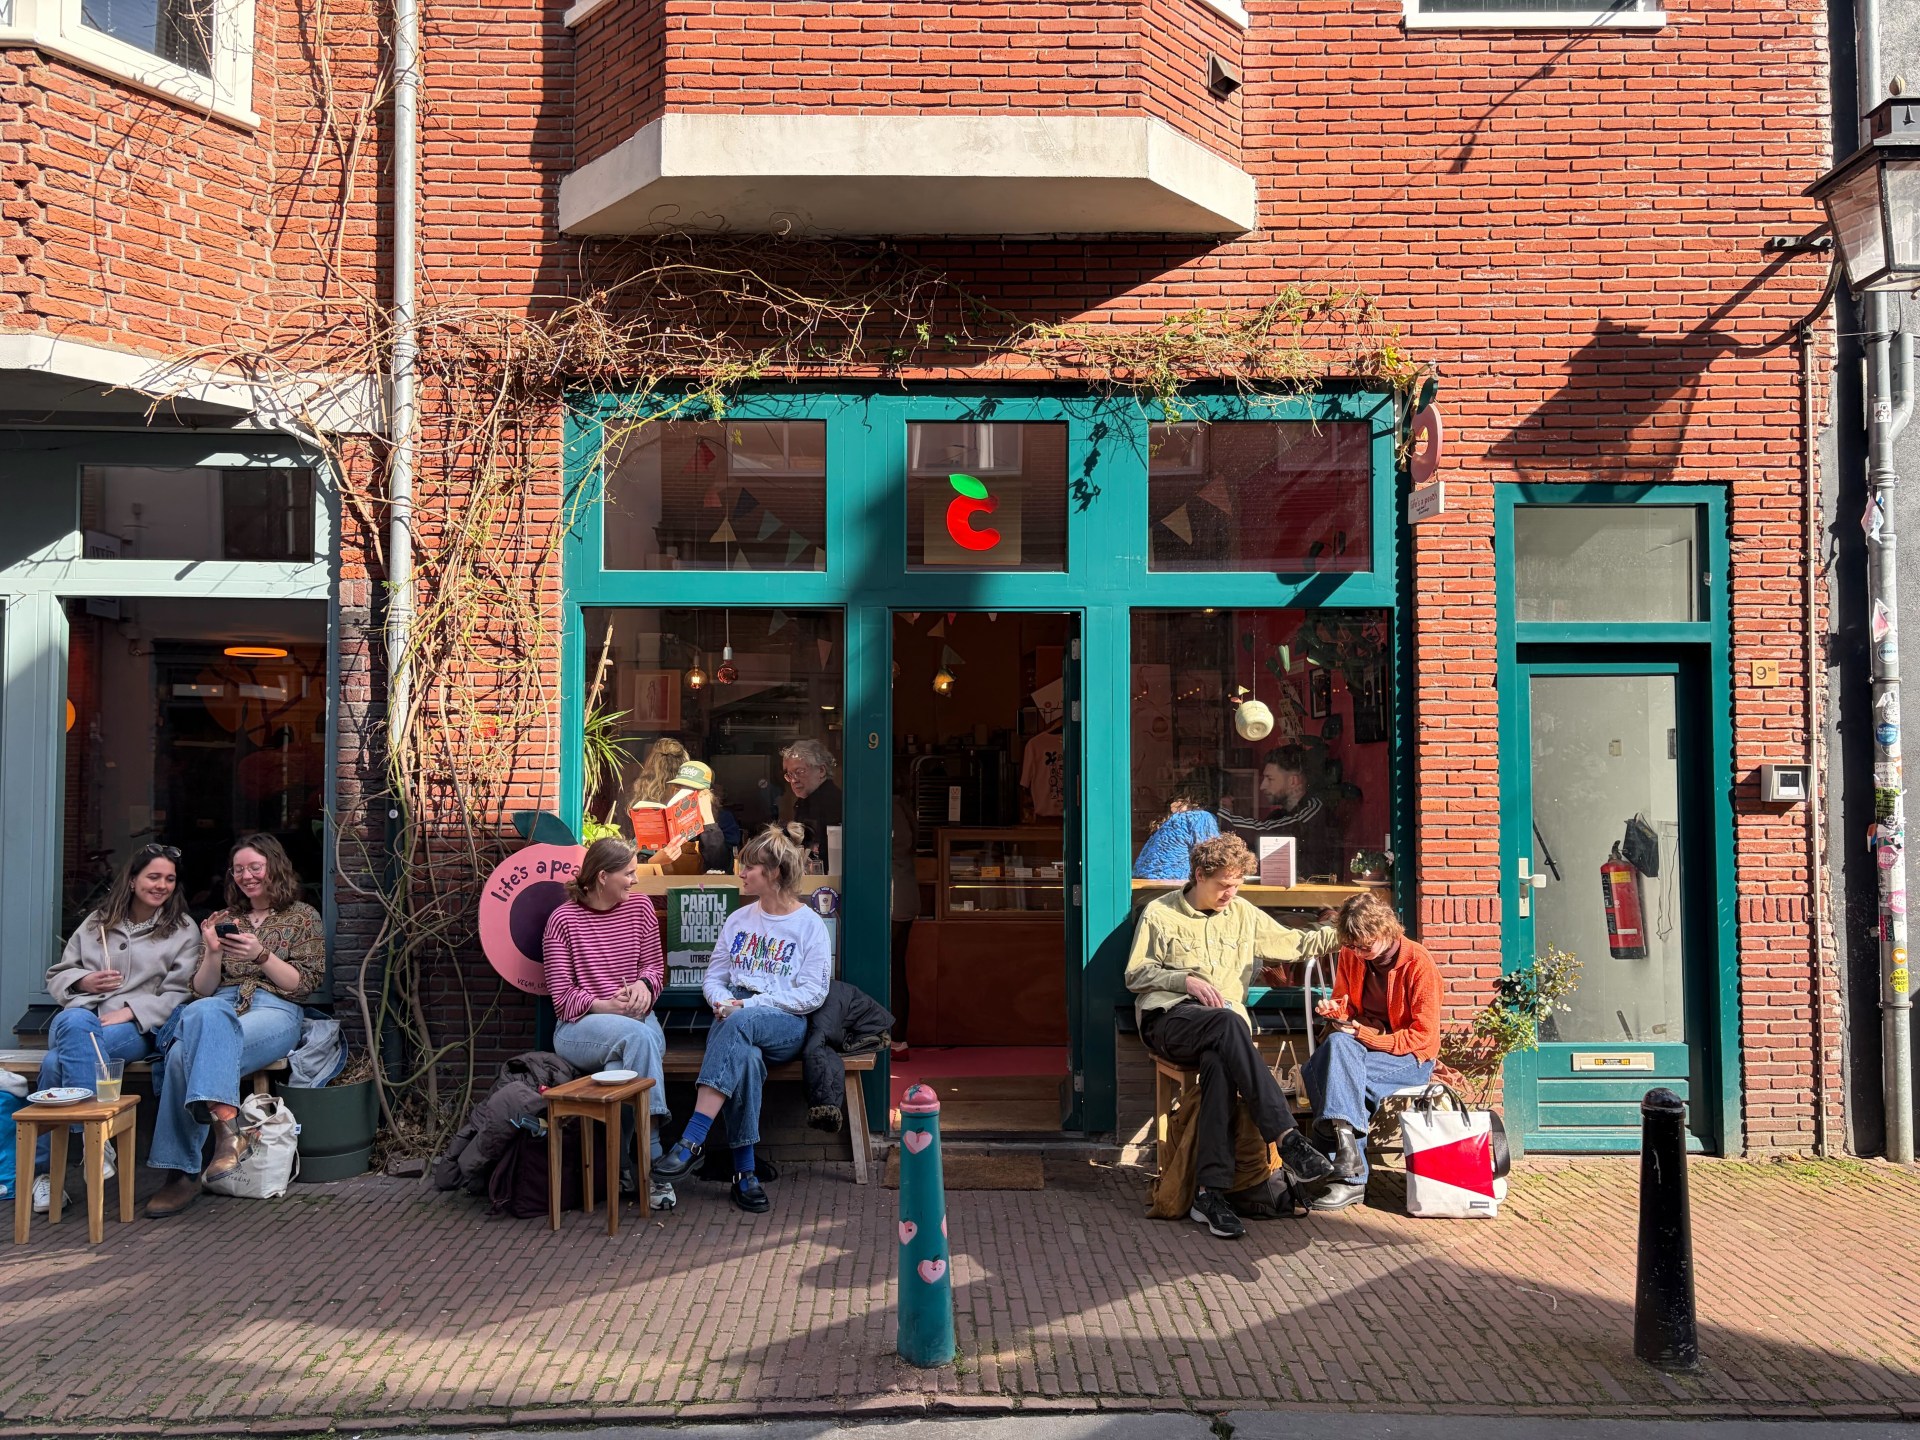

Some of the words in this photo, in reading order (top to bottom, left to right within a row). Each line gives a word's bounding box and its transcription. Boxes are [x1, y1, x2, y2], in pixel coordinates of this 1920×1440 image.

[1756, 666, 1767, 680] 9
[869, 732, 879, 749] 9
[490, 866, 529, 903] life's
[536, 861, 547, 874] a
[550, 860, 581, 880] pea
[681, 894, 727, 912] PARTIJ
[681, 911, 710, 926] VOOR
[713, 911, 727, 926] DE
[690, 954, 710, 963] UTREC
[670, 969, 704, 983] NATUU
